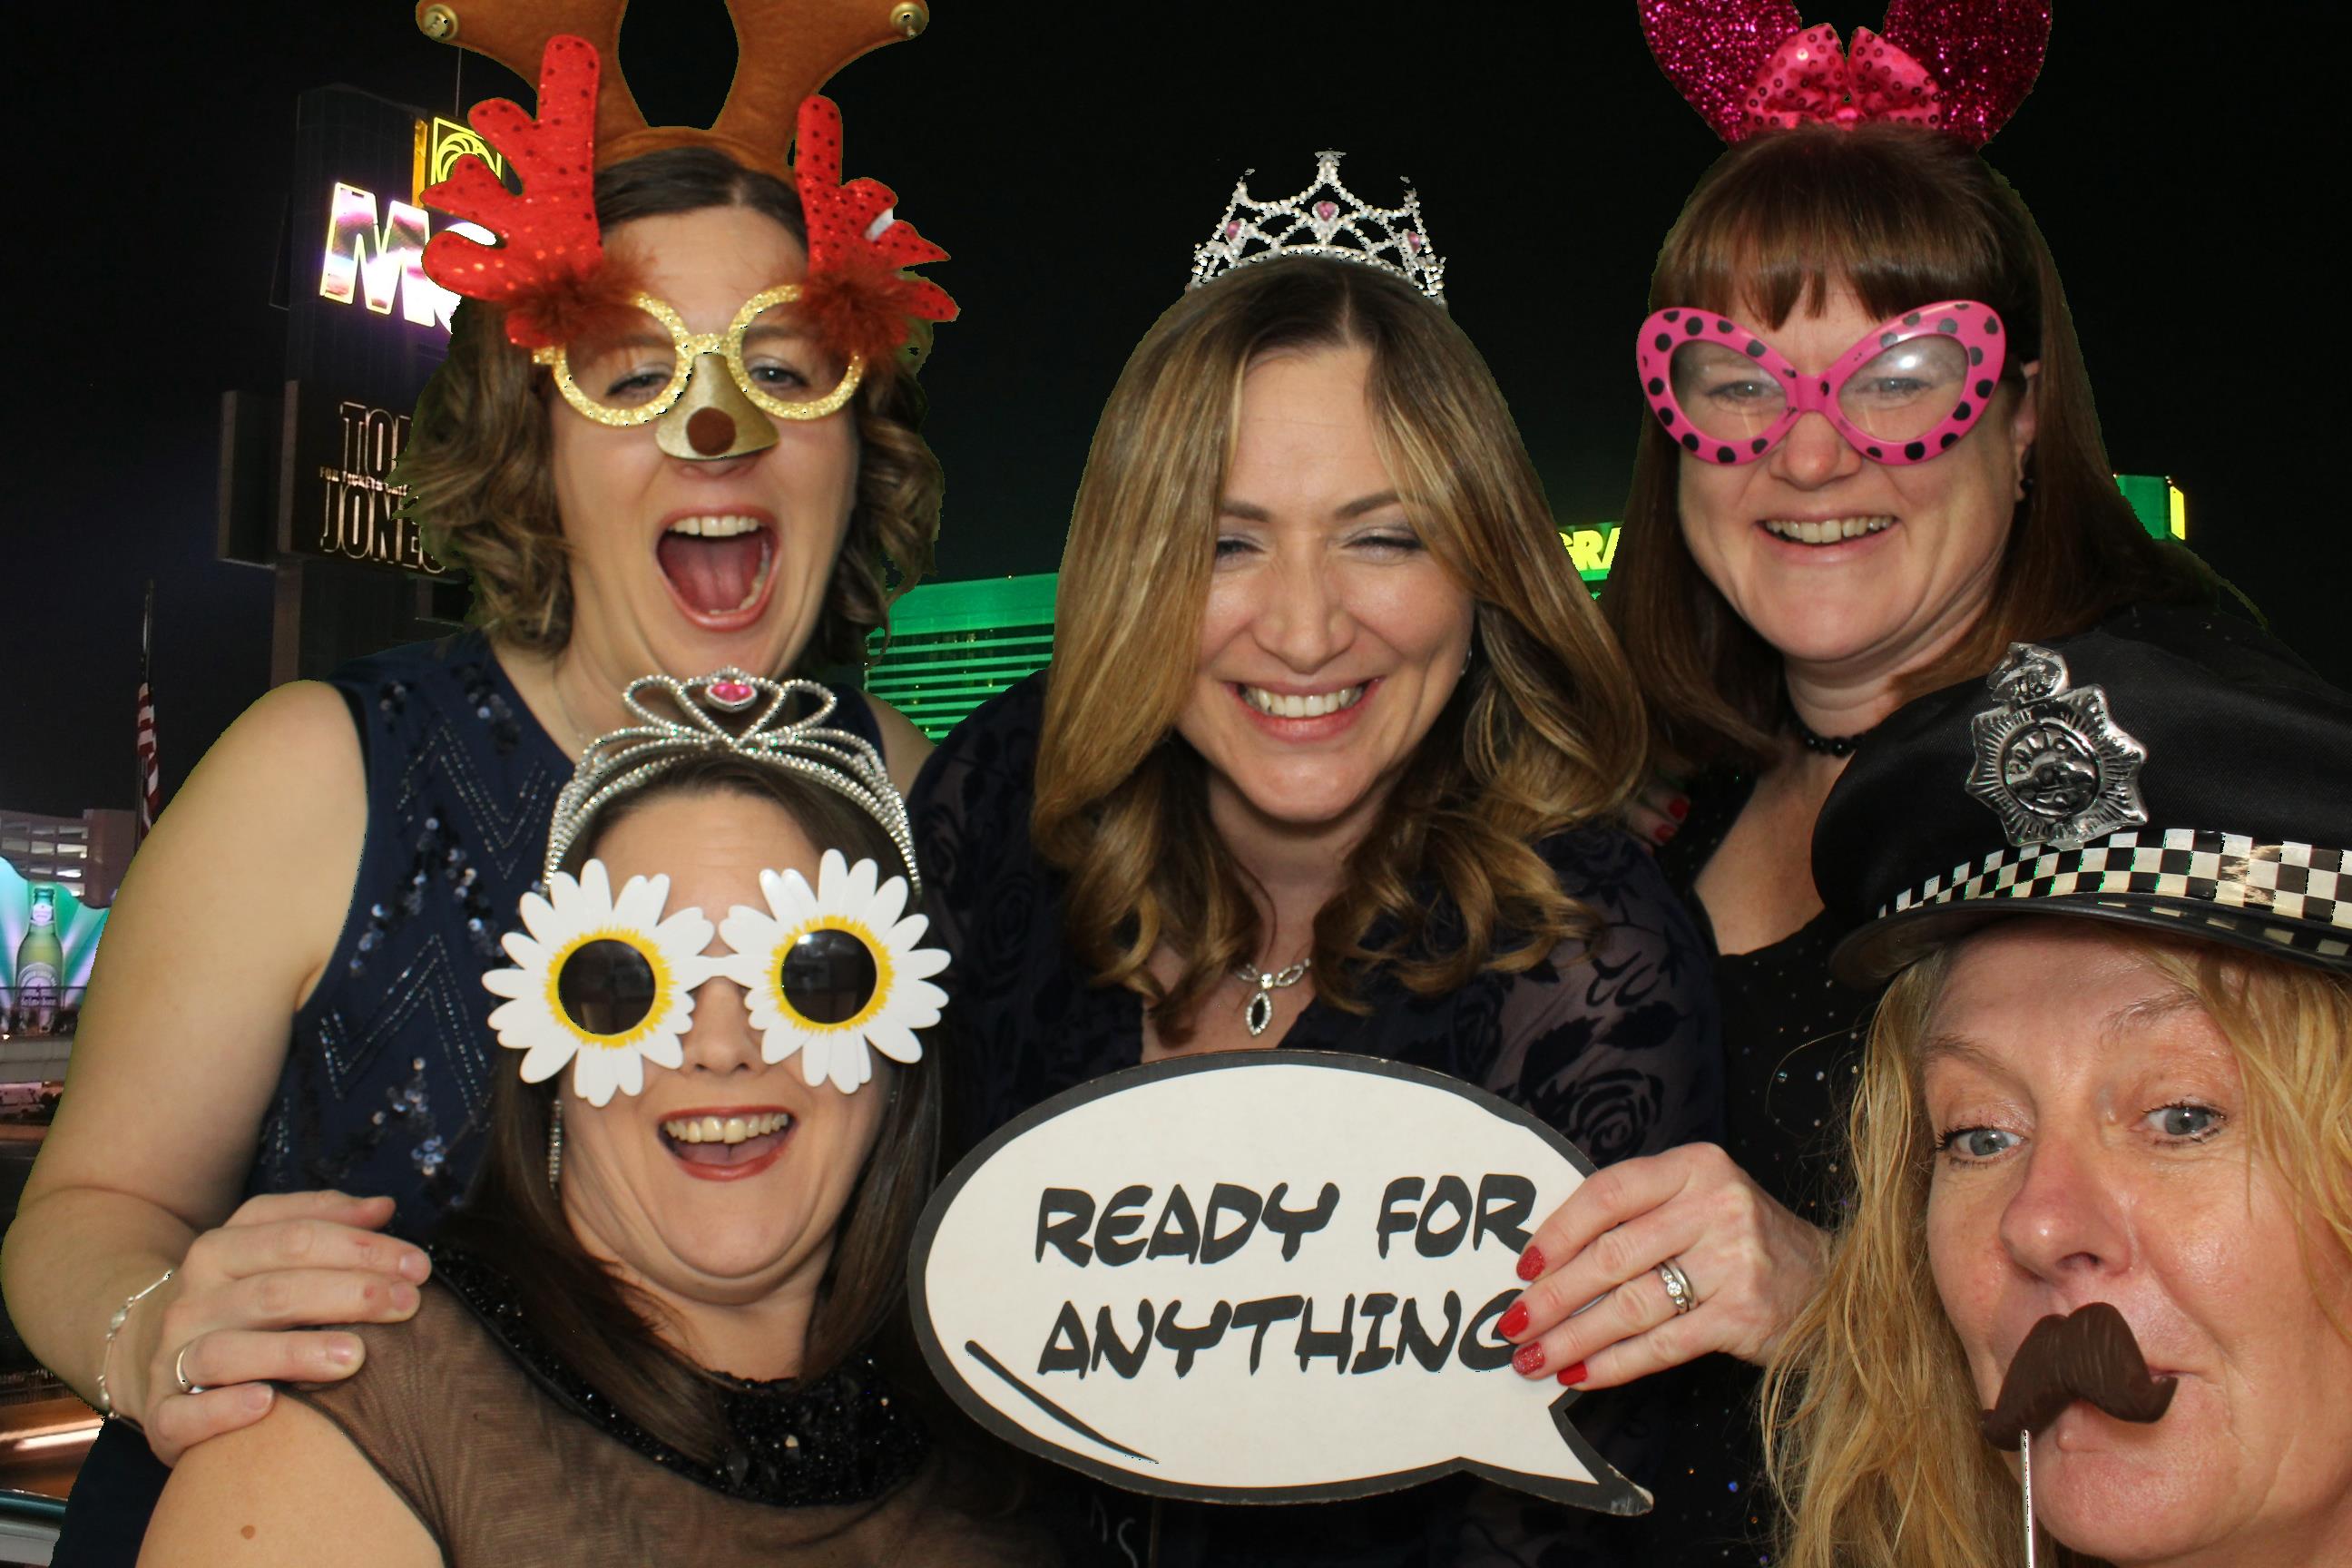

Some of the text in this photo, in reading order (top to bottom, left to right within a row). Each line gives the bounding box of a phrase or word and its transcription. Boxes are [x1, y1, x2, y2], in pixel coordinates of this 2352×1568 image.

[1035, 1173, 1537, 1268] READY FOR
[1037, 1289, 1525, 1379] ANYTHING
